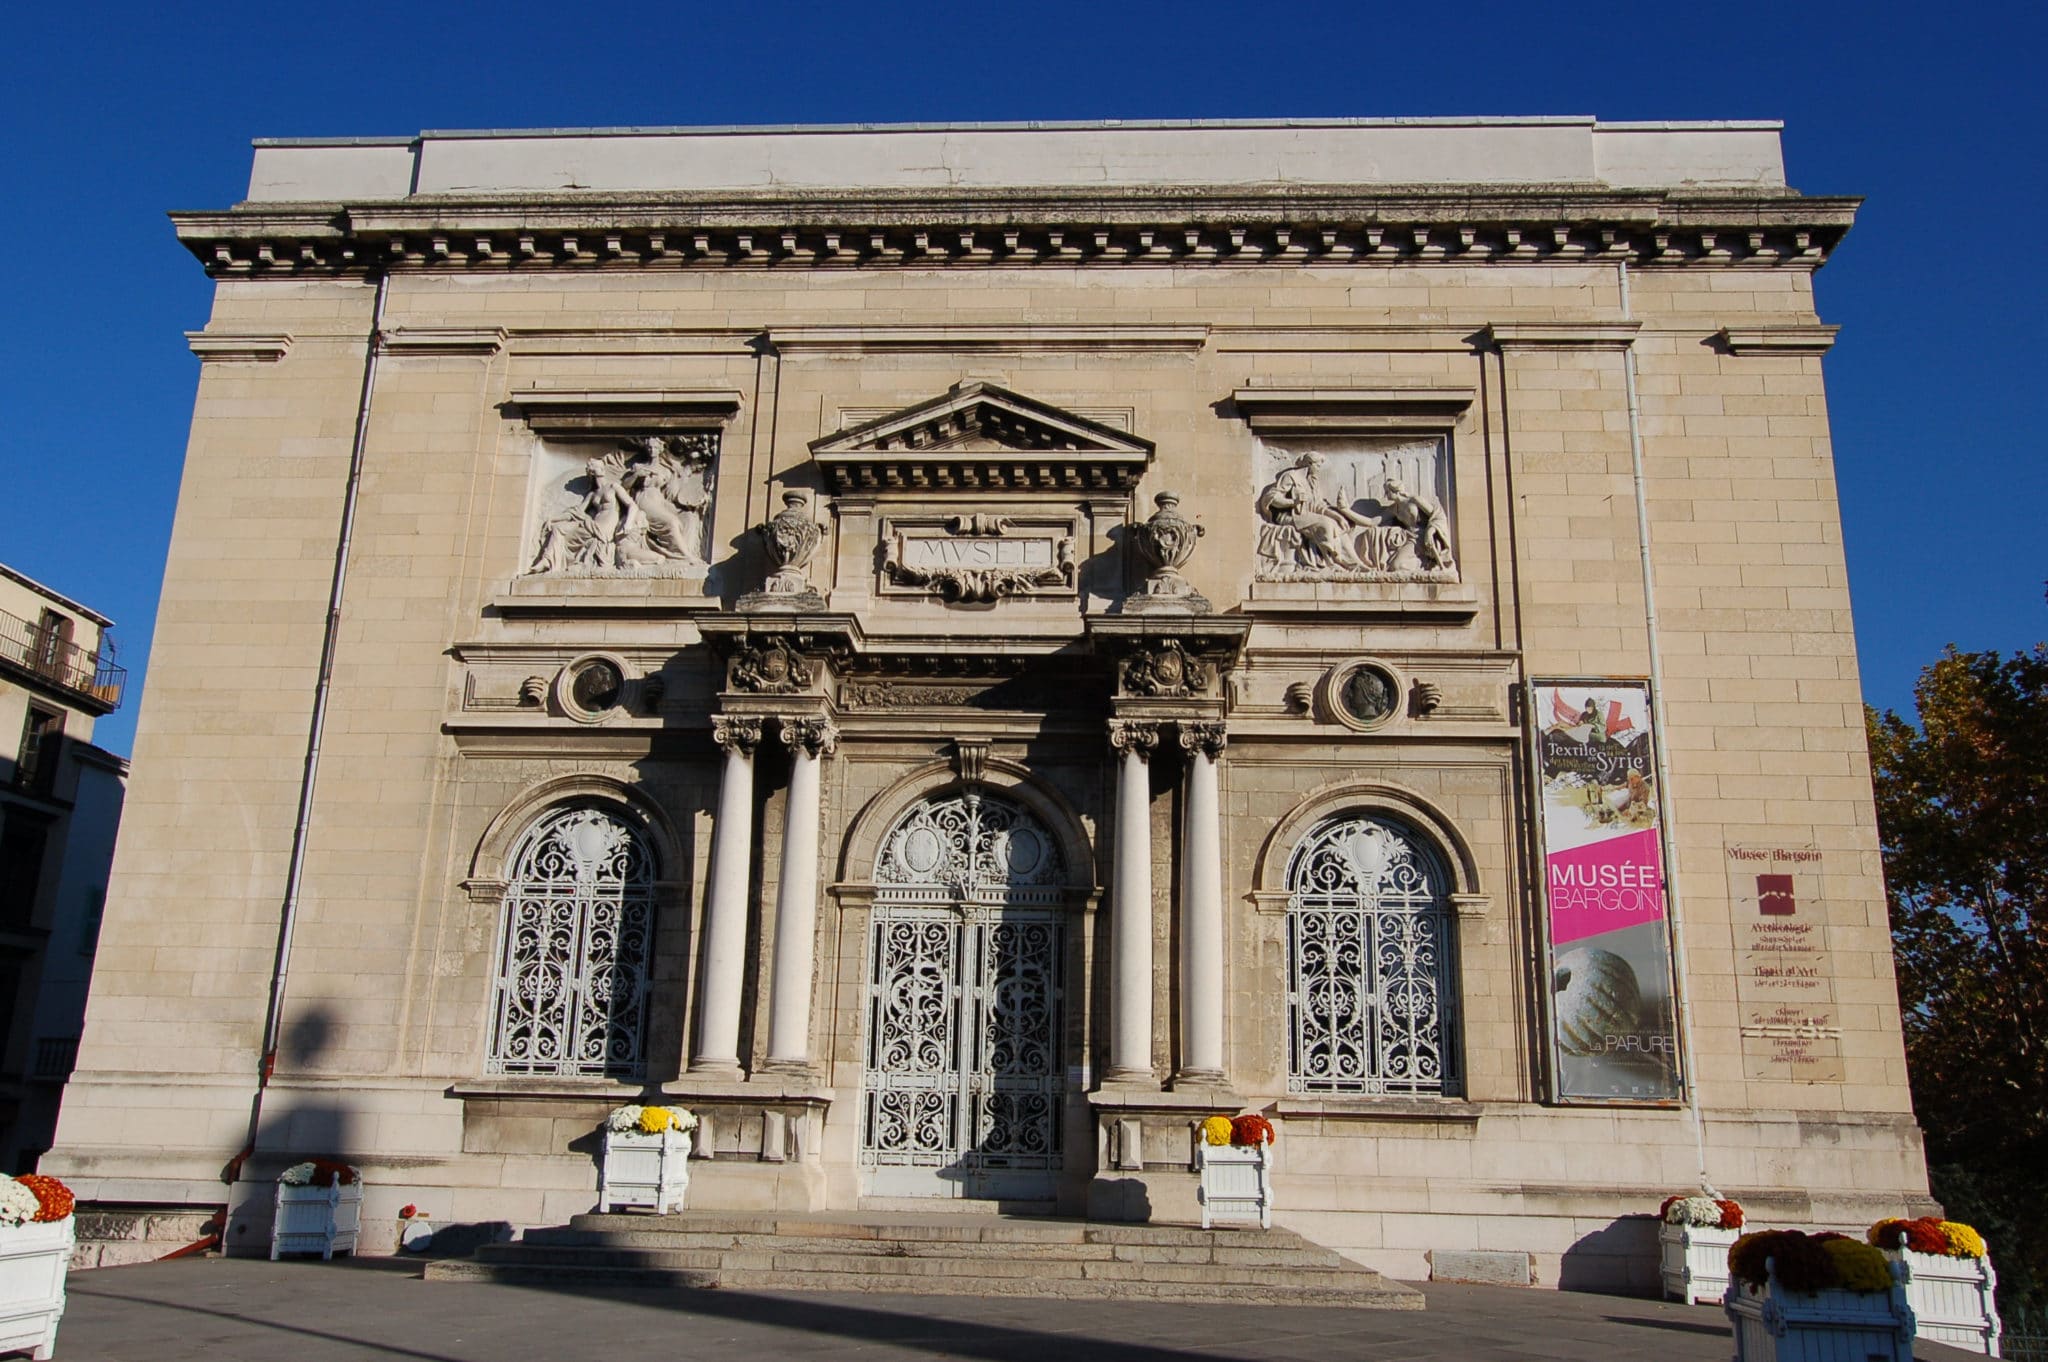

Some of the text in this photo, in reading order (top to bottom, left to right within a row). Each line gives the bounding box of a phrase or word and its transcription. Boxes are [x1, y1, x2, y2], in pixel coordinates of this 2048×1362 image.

[919, 540, 1043, 564] MVSEE
[1548, 742, 1597, 757] Textile
[1596, 752, 1644, 775] Syrie
[1552, 860, 1656, 888] MUSÉE
[1553, 887, 1659, 911] BARGOIN
[1605, 1034, 1675, 1053] PARURE
